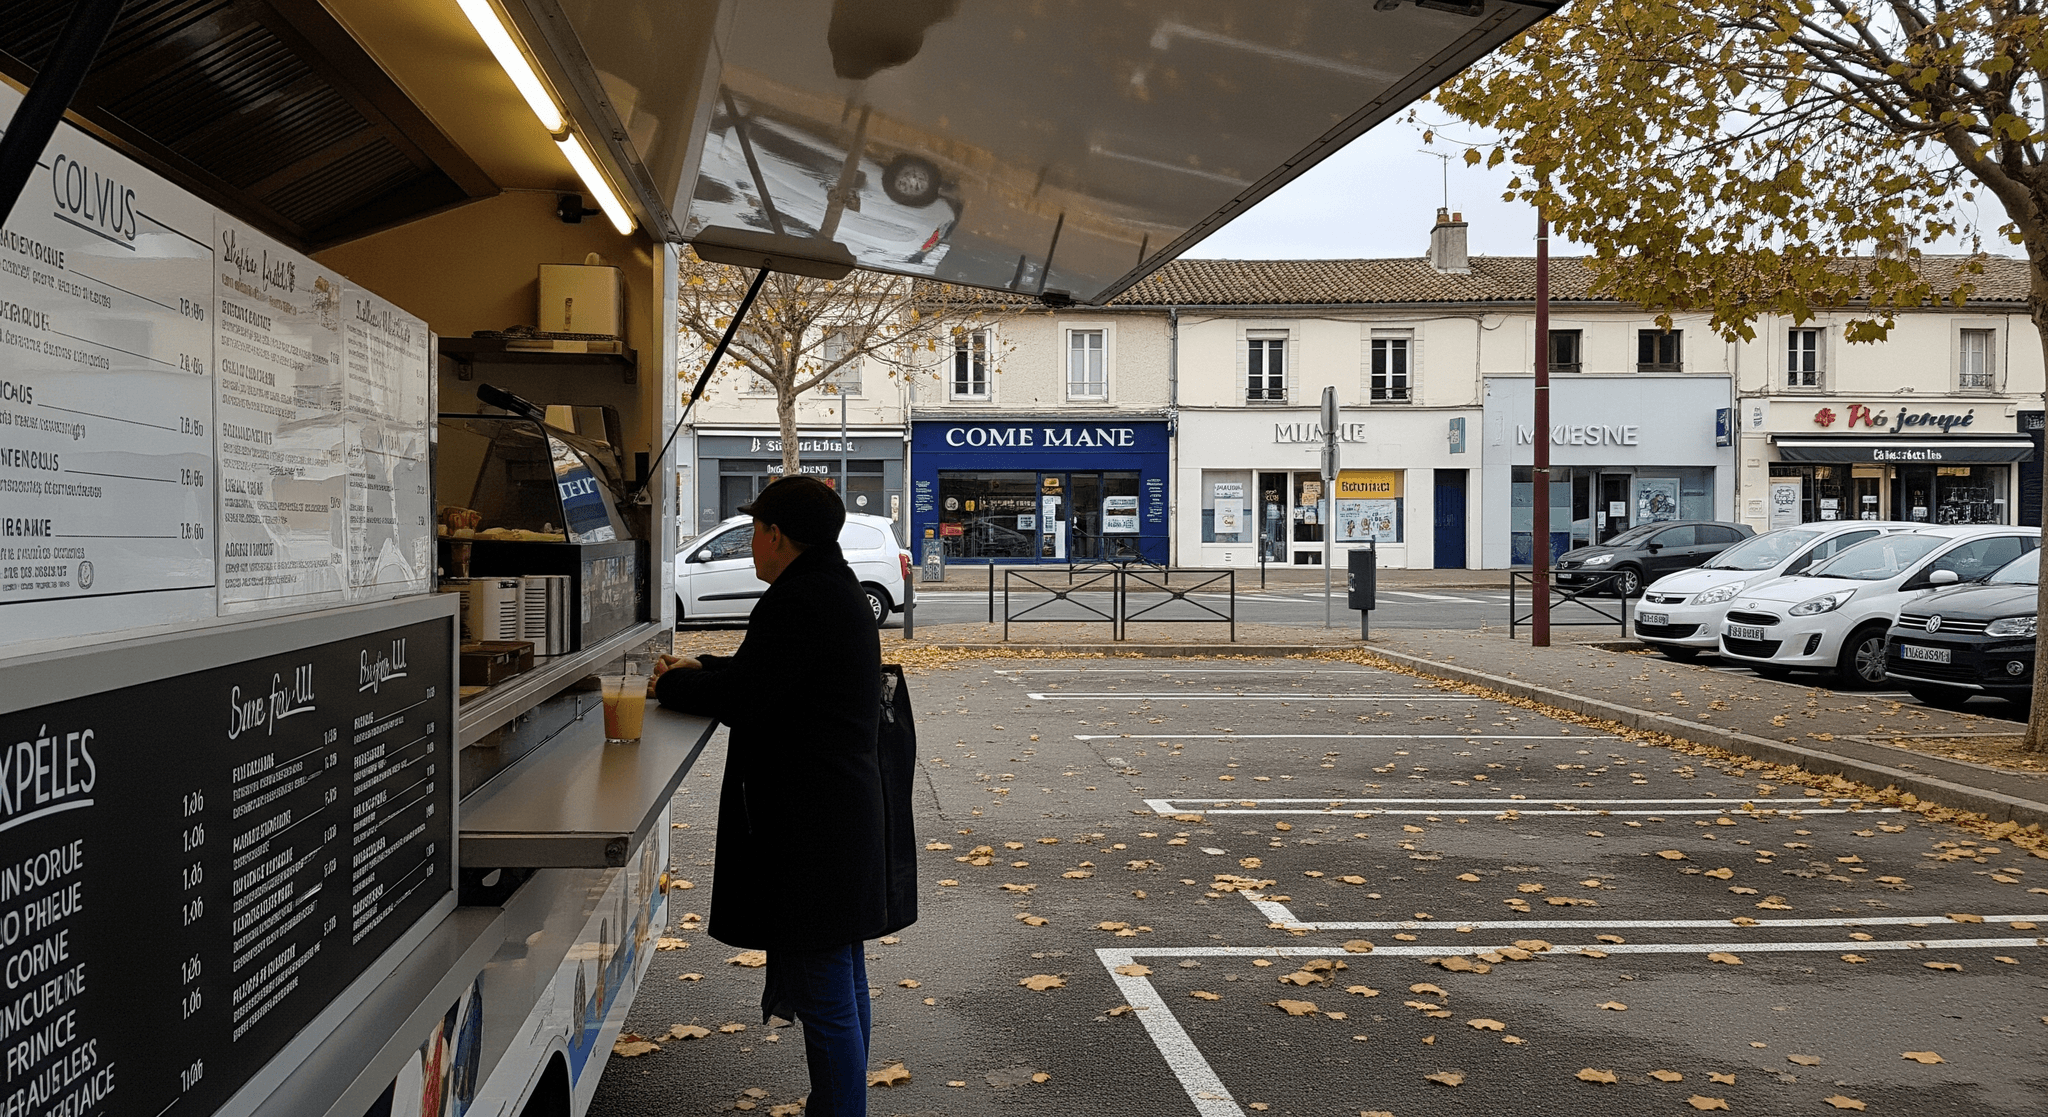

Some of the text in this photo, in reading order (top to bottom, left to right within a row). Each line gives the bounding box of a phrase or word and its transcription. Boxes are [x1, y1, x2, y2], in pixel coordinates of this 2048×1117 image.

[52, 154, 136, 241] COLVUS
[945, 427, 1136, 447] COME MANE
[24, 838, 84, 892] SORUE
[6, 929, 69, 990] CORNE
[7, 1009, 77, 1083] FRINICE
